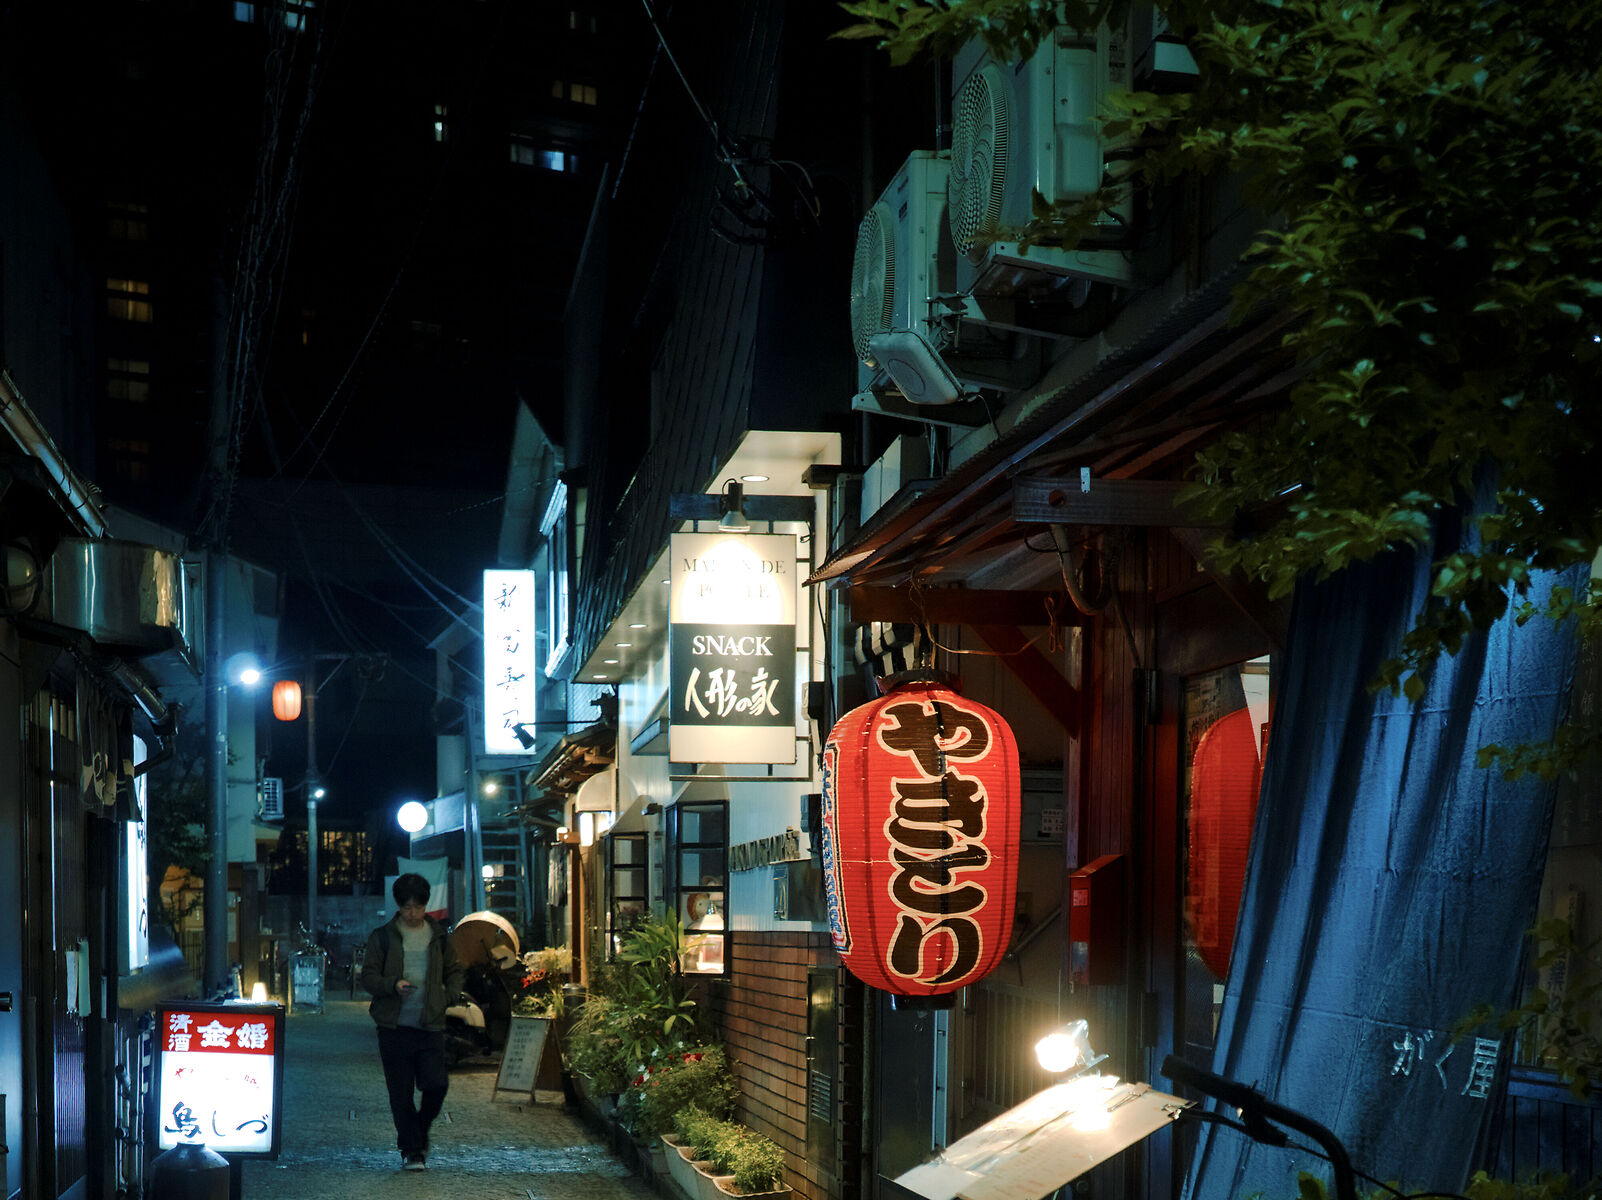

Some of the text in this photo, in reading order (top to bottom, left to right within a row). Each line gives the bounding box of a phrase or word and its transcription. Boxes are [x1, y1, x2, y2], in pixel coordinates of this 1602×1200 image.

[762, 560, 786, 575] DE
[692, 635, 773, 656] SNACK
[684, 666, 780, 718] 人形の家
[877, 700, 992, 985] やきとり
[168, 1013, 193, 1052] 清酒
[197, 1019, 269, 1049] 金婚
